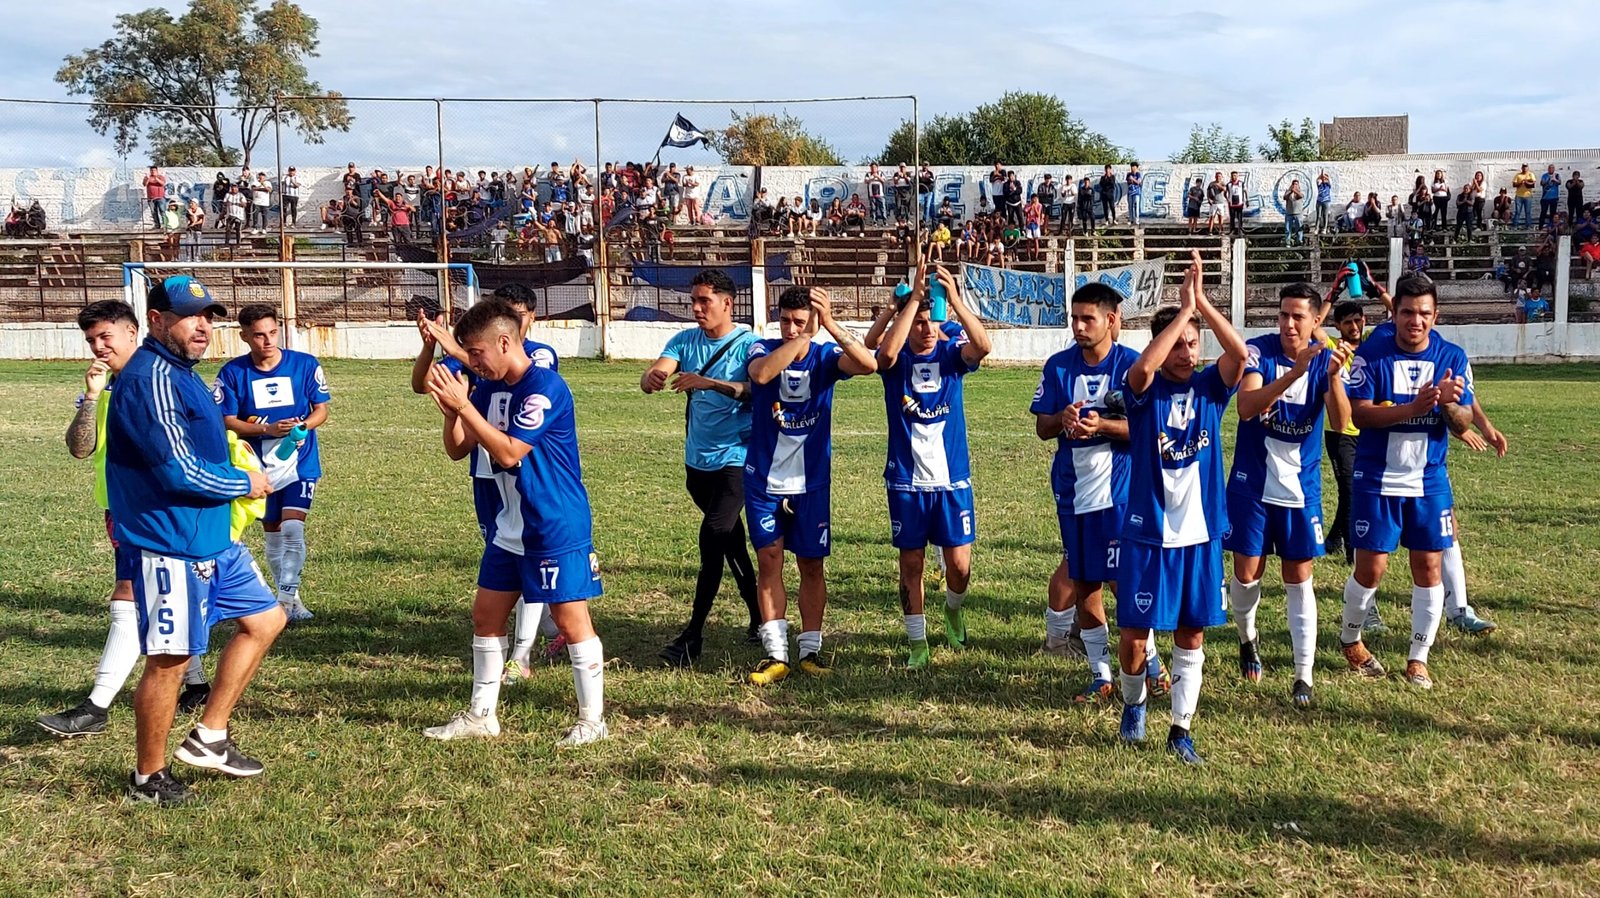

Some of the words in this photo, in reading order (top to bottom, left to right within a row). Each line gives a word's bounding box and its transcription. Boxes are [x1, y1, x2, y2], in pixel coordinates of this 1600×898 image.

[300, 481, 315, 500] 13
[962, 515, 972, 536] 6
[1314, 523, 1325, 545] 8
[819, 528, 829, 548] 4
[540, 566, 560, 590] 17
